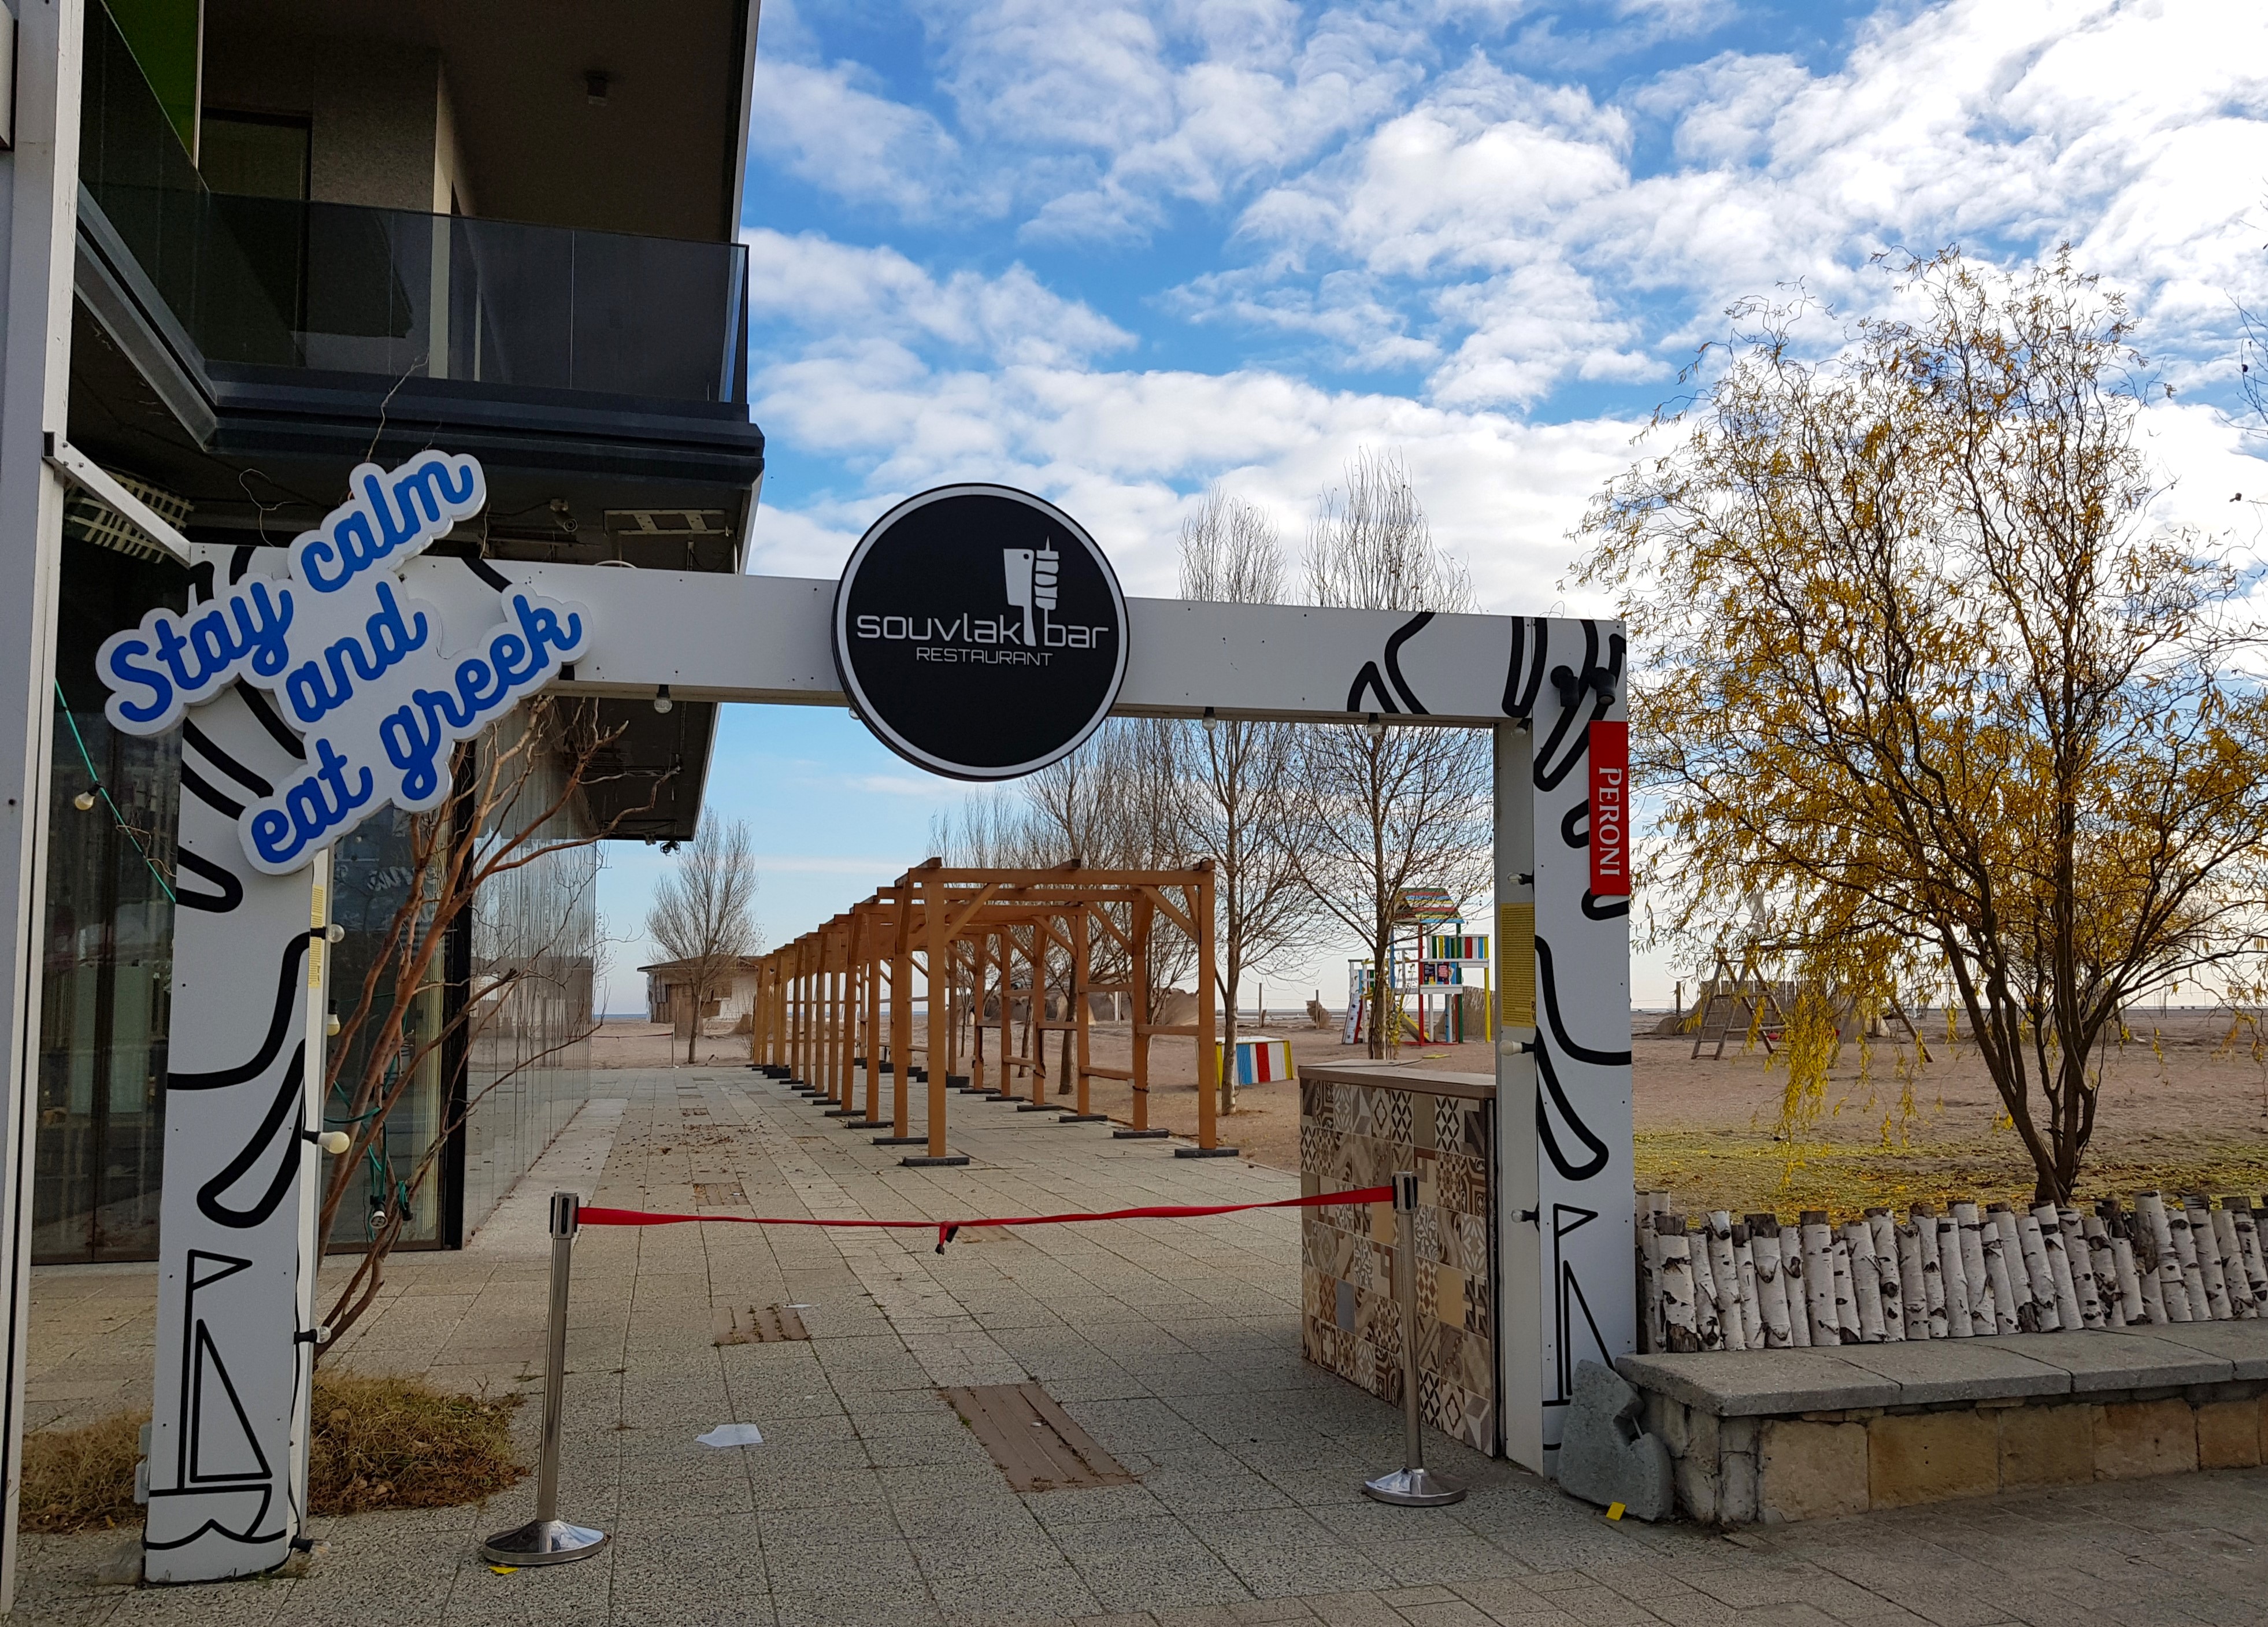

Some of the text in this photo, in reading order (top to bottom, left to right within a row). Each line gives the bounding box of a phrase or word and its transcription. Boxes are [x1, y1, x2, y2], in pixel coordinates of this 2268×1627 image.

[110, 461, 475, 722] Stay calm
[286, 581, 428, 723] and
[1044, 609, 1109, 649] bar
[916, 646, 1054, 666] RESTAURANT
[251, 594, 583, 863] eat greek
[1599, 767, 1622, 876] PERONI
